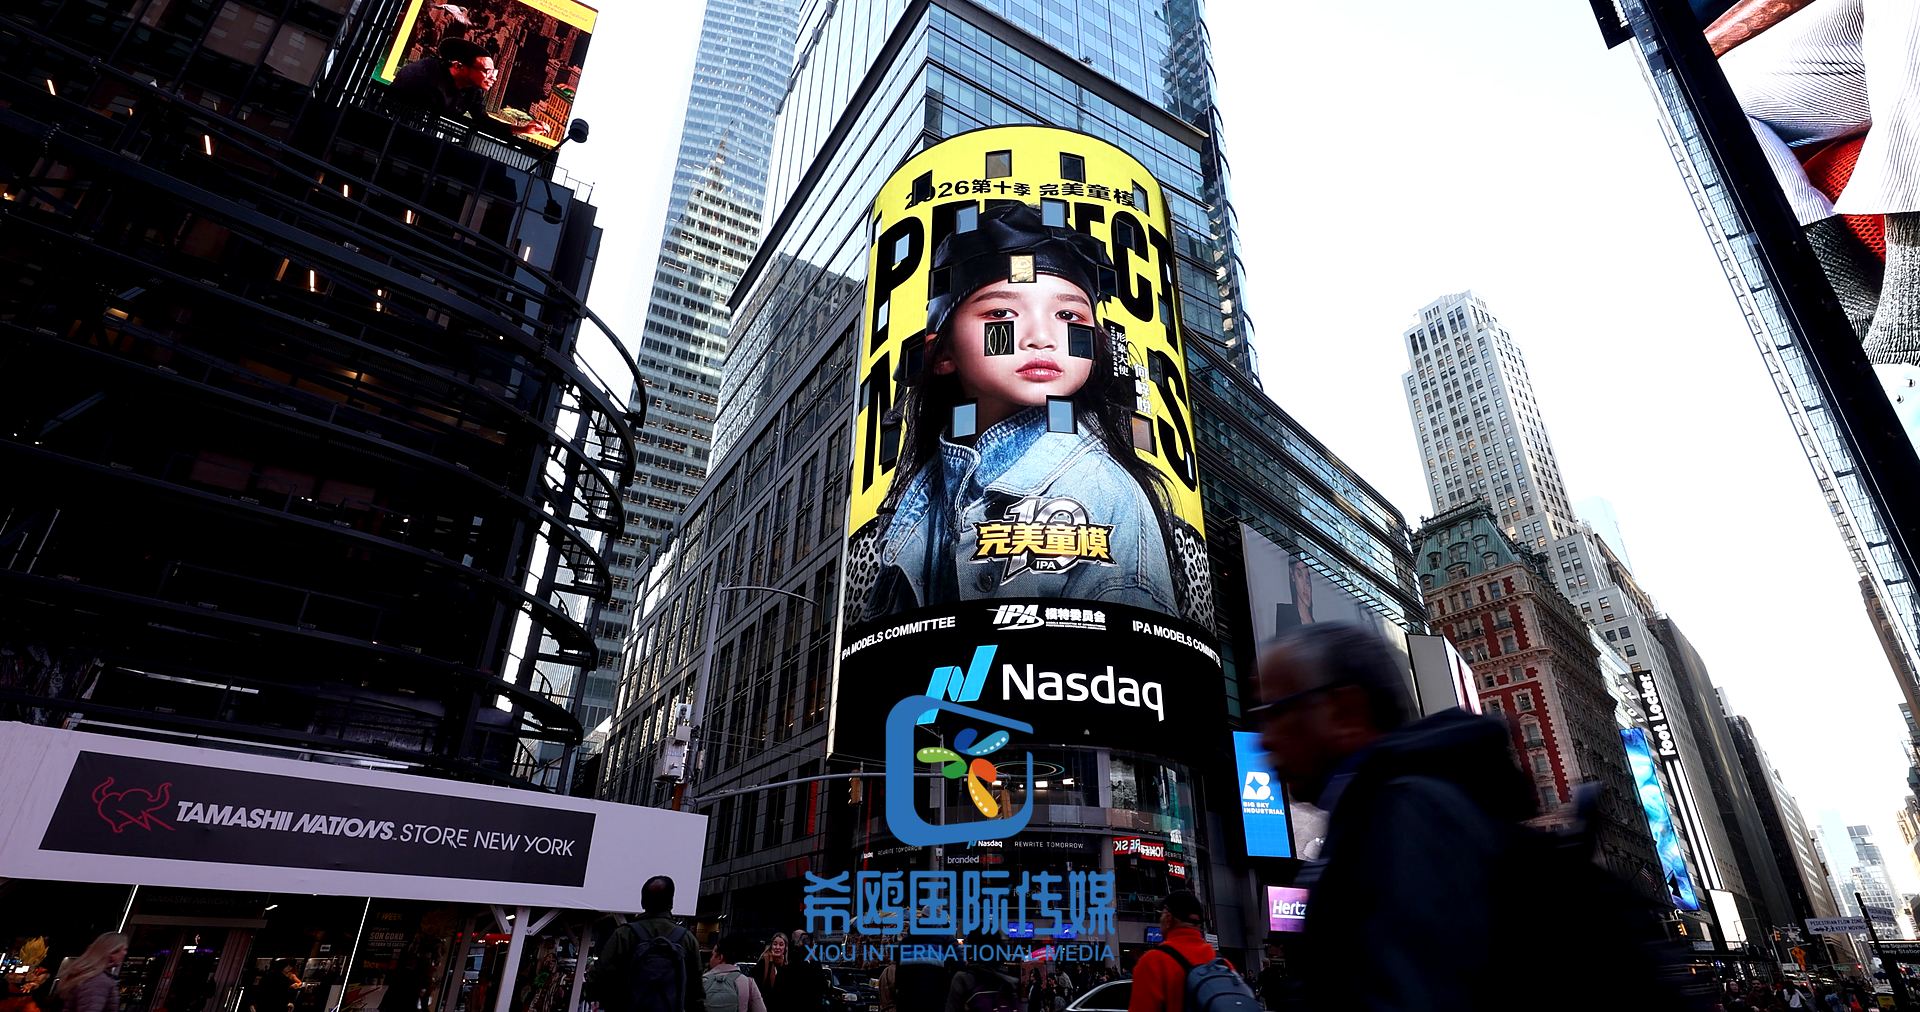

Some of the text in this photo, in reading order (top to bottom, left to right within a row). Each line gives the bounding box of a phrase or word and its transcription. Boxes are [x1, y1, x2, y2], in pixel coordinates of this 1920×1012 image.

[1116, 331, 1129, 377] 形象大使
[976, 523, 1110, 560] 完美童模
[1036, 561, 1056, 570] IPA
[992, 604, 1039, 625] IPA
[1045, 607, 1106, 624] 模特委员会
[850, 631, 884, 655] MODELS
[884, 616, 956, 640] COMMITTEE
[1132, 620, 1152, 635] IPA
[1153, 624, 1193, 647] MODELS
[1002, 663, 1165, 722] Nasdaq
[1639, 673, 1677, 756] Foot Locker
[1243, 807, 1285, 816] INDUSTRIAL
[176, 800, 577, 857] TAMASHII NATIONS STORE NEW YORK
[978, 840, 1003, 849] Nasdaq
[1047, 841, 1084, 849] TOMORROW
[947, 855, 980, 864] branded
[1272, 900, 1307, 916] Hertz
